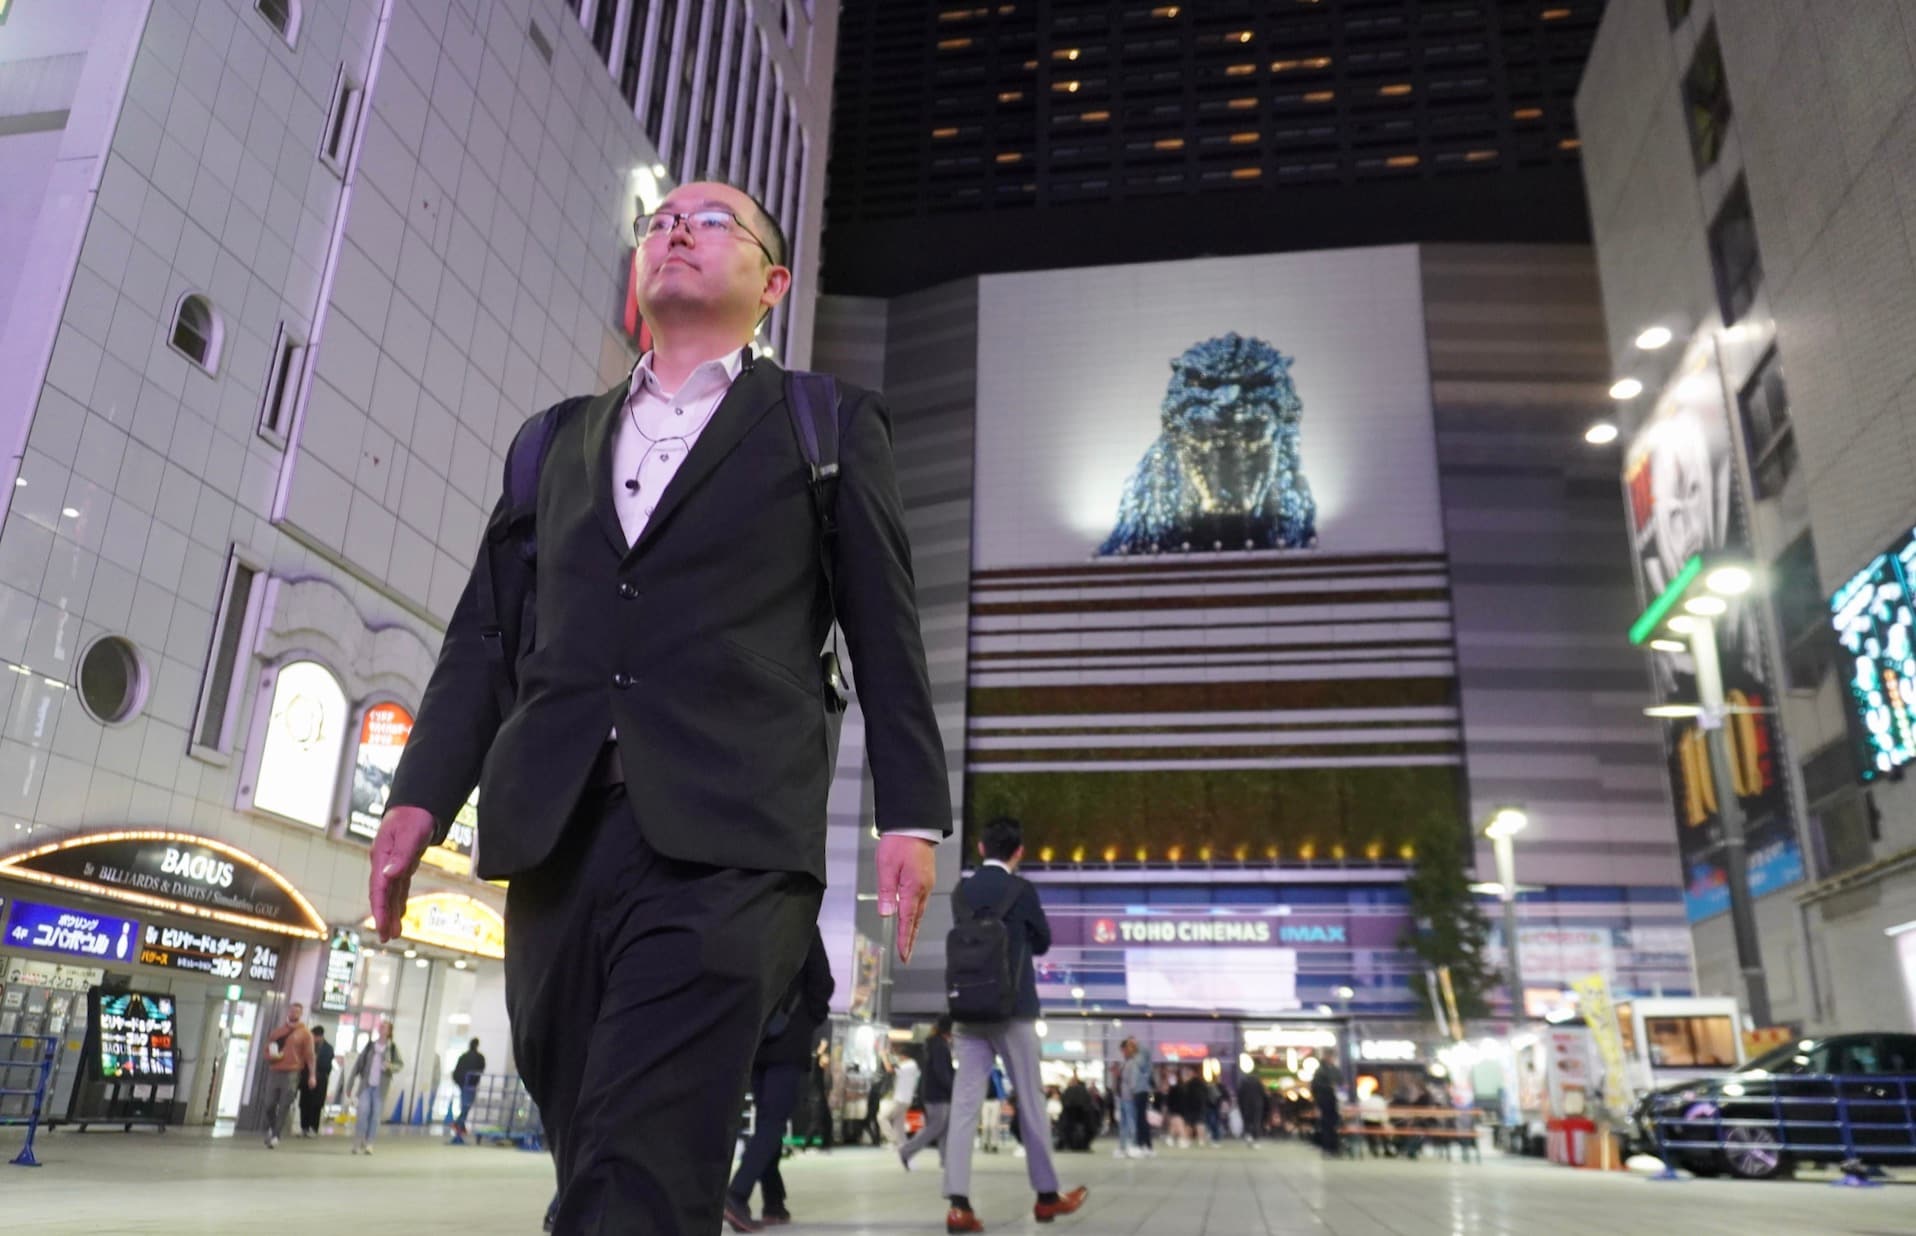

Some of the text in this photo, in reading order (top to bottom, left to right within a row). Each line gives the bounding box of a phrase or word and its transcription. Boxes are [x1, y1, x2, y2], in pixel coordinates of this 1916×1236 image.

[161, 848, 234, 888] BAGUS
[99, 865, 158, 891] BILLIARDS
[160, 880, 171, 892] &
[172, 882, 207, 901] DARTS
[255, 903, 281, 918] GOLF
[12, 926, 29, 940] 4F
[1120, 921, 1270, 941] TOHO CINEMAS
[1279, 925, 1346, 942] IMAX
[249, 965, 276, 981] OPEN
